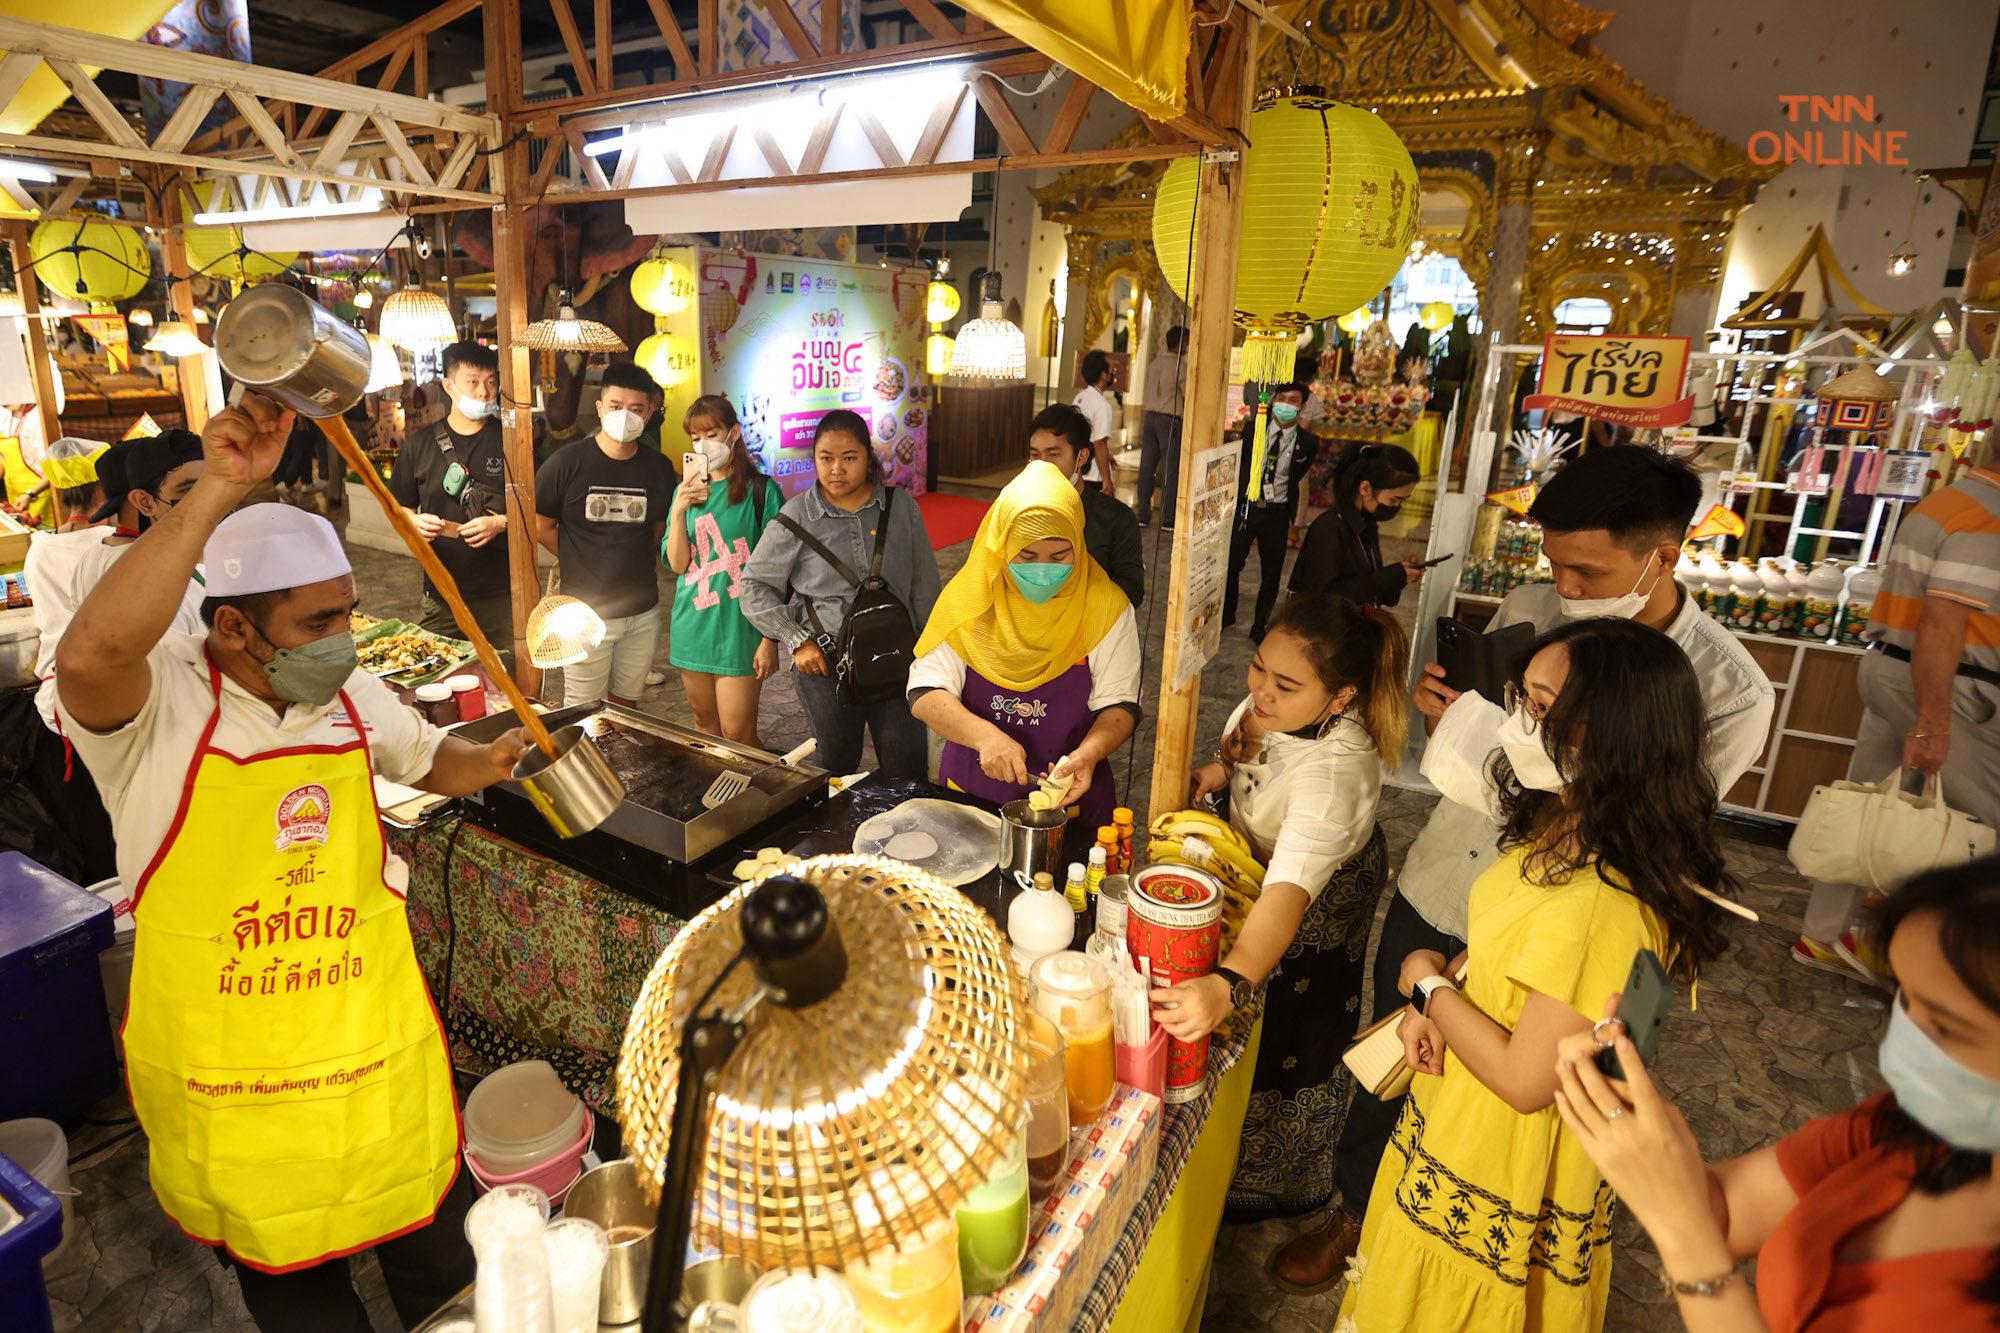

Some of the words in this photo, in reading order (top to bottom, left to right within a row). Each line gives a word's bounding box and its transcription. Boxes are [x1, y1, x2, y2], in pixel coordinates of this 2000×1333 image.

[1591, 341, 1662, 369] เรียล
[1554, 348, 1659, 398] ไทย
[777, 461, 792, 476] 22
[995, 712, 1039, 726] SIAM
[280, 789, 307, 821] GOLDEN
[307, 786, 330, 818] MOUNTAIN
[285, 825, 325, 839] ภูเขาทอง
[232, 894, 356, 952] ดีต่อเจ
[1138, 902, 1158, 919] PLEASE
[1158, 910, 1178, 923] DRINK
[1180, 913, 1196, 923] THAI
[1196, 912, 1207, 922] TEA
[249, 1074, 320, 1095] เพิ่มแต้มบุญ
[326, 1058, 386, 1085] เสริมสุขภาพ
